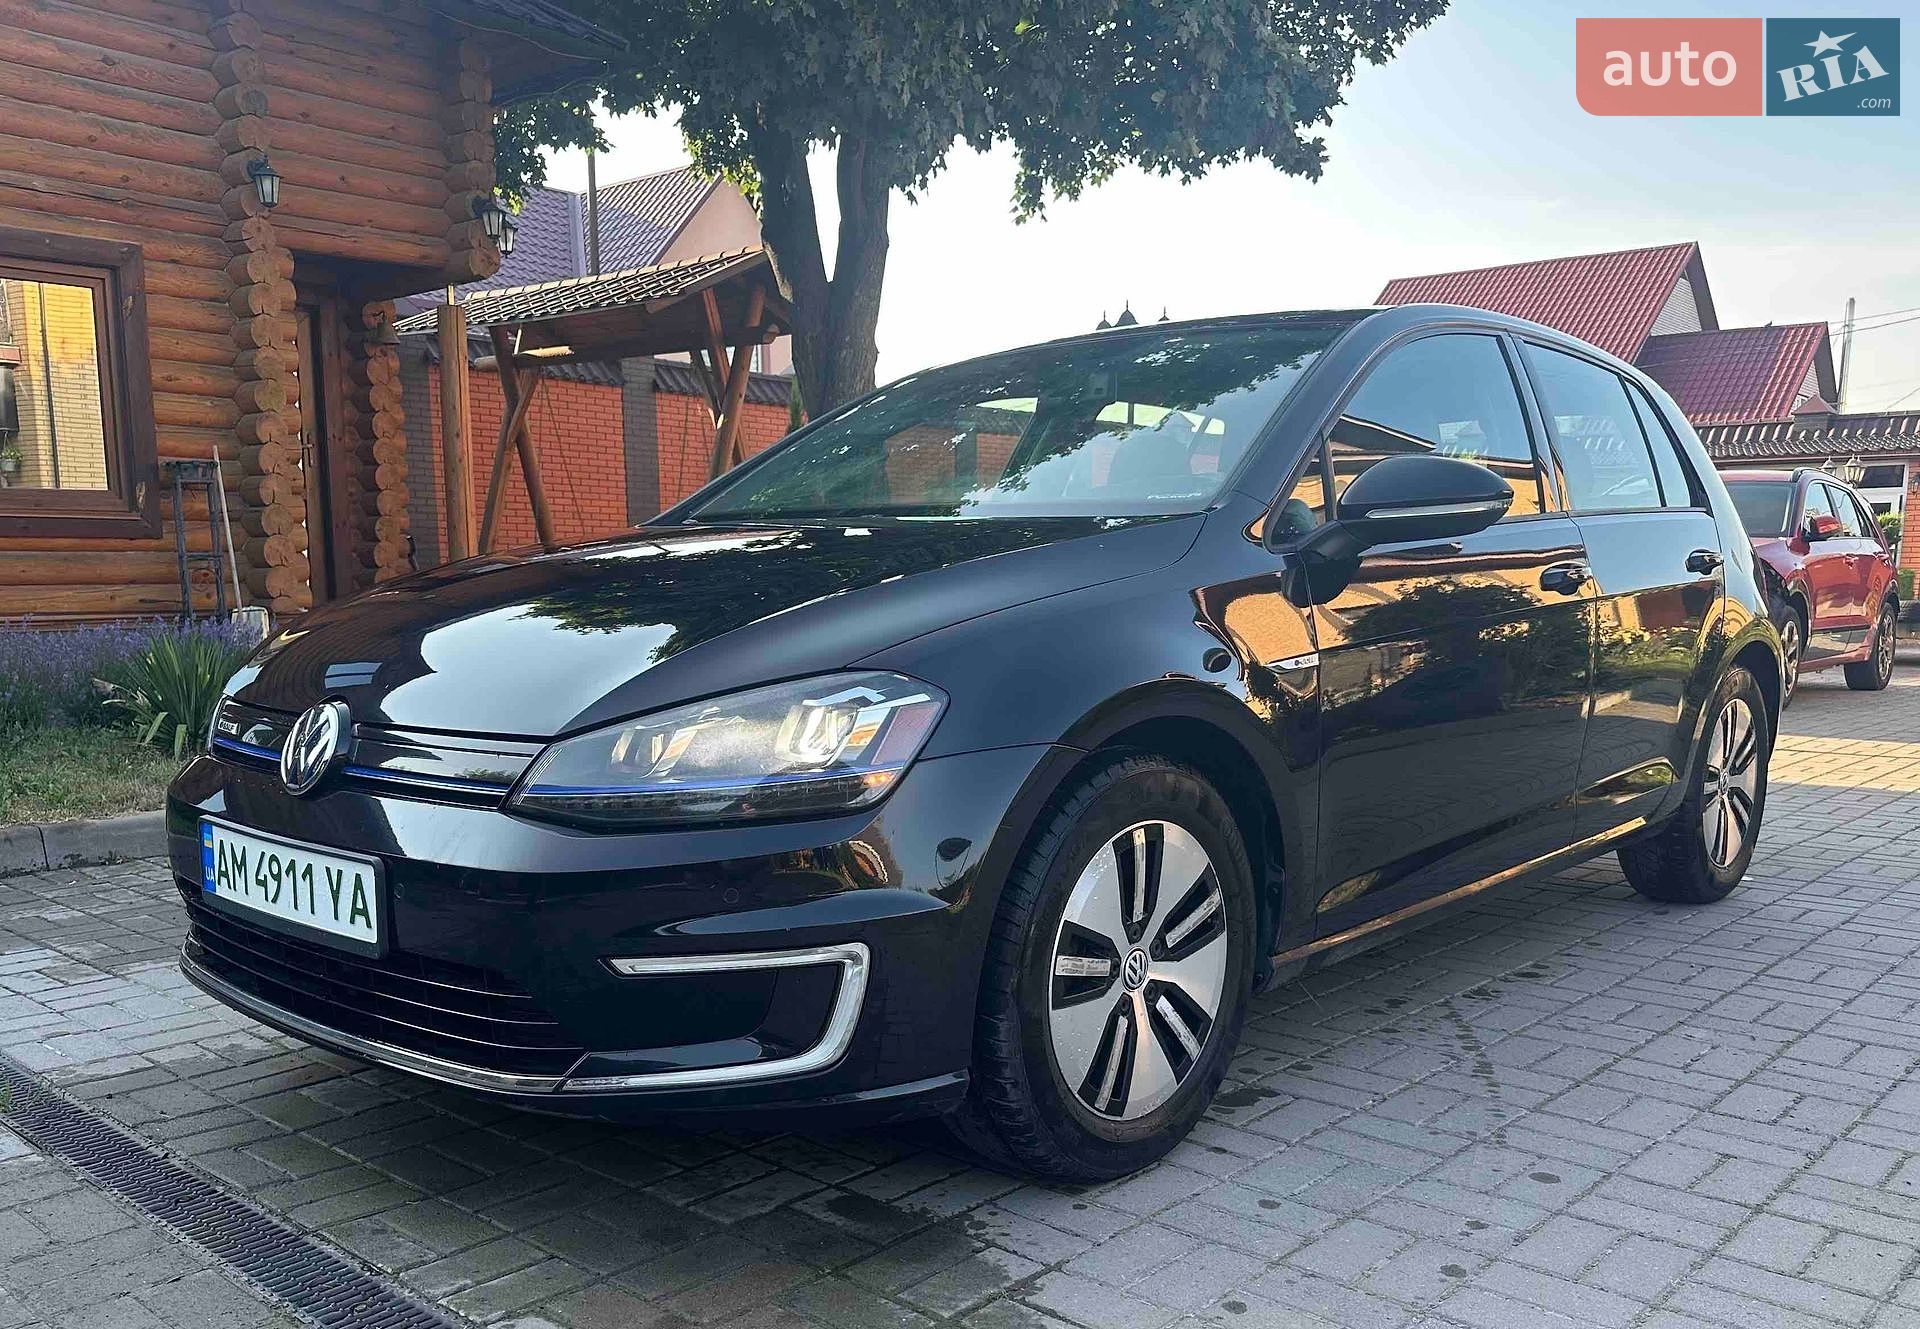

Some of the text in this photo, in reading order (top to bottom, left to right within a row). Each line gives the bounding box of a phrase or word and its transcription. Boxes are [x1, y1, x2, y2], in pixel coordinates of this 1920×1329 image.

[205, 865, 215, 881] UA
[217, 839, 372, 929] AM 4911 YA
